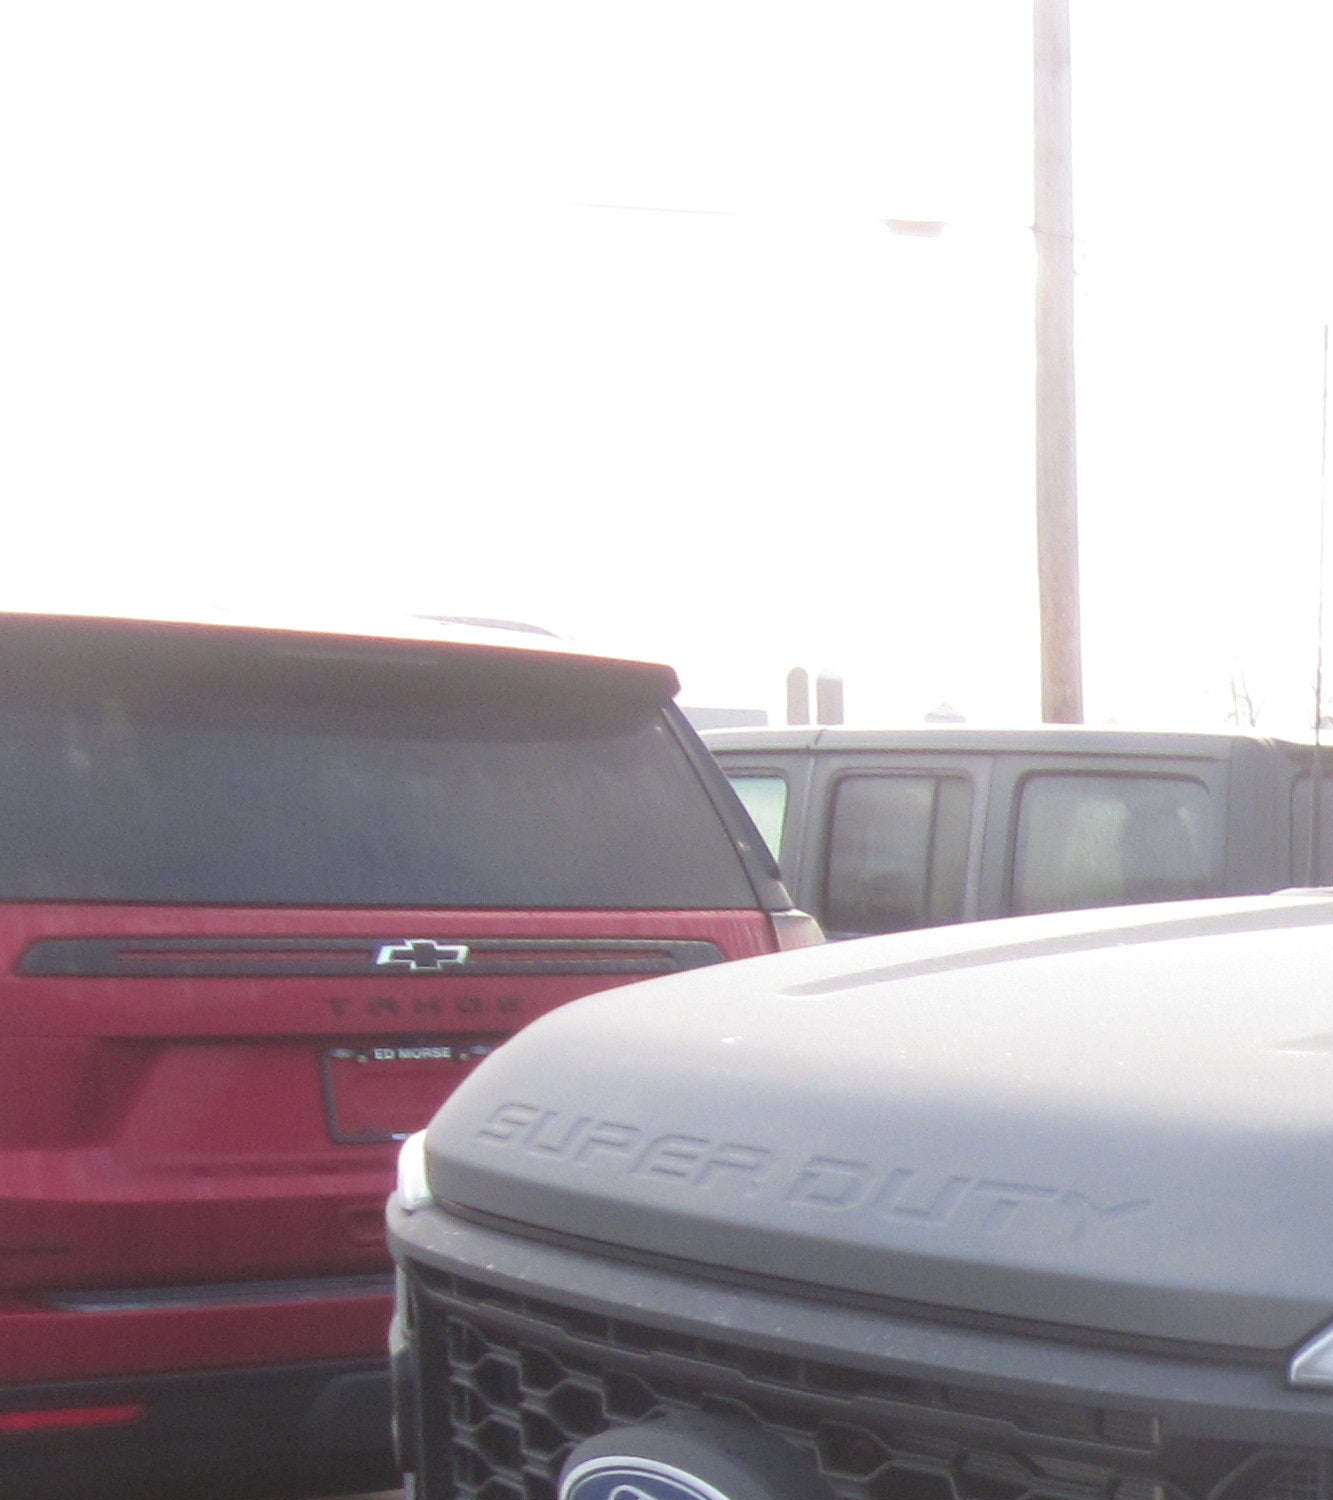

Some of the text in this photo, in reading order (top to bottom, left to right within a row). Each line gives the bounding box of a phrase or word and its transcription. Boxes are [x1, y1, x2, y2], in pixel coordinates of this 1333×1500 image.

[328, 996, 522, 1016] TAHOE
[373, 1046, 451, 1060] ED MORSE
[477, 1099, 1152, 1243] SUPER DUTY
